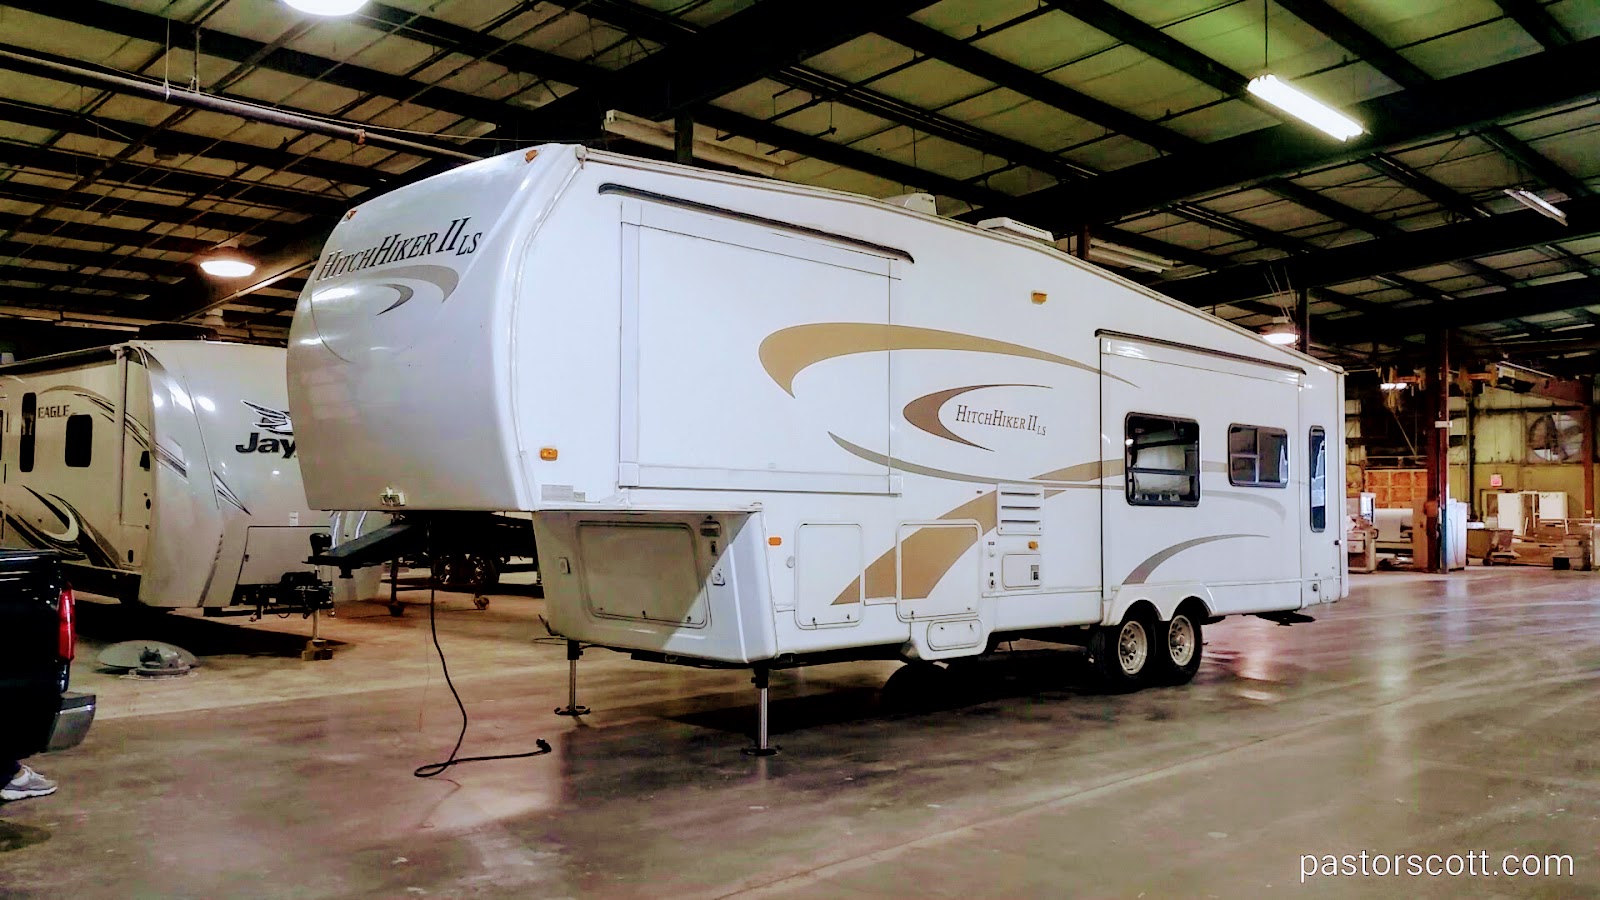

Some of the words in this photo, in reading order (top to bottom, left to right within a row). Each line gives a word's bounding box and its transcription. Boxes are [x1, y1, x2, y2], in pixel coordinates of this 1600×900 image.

[435, 215, 472, 253] II
[455, 231, 483, 257] LS
[37, 404, 70, 419] EAGLE
[235, 432, 297, 459] Jay
